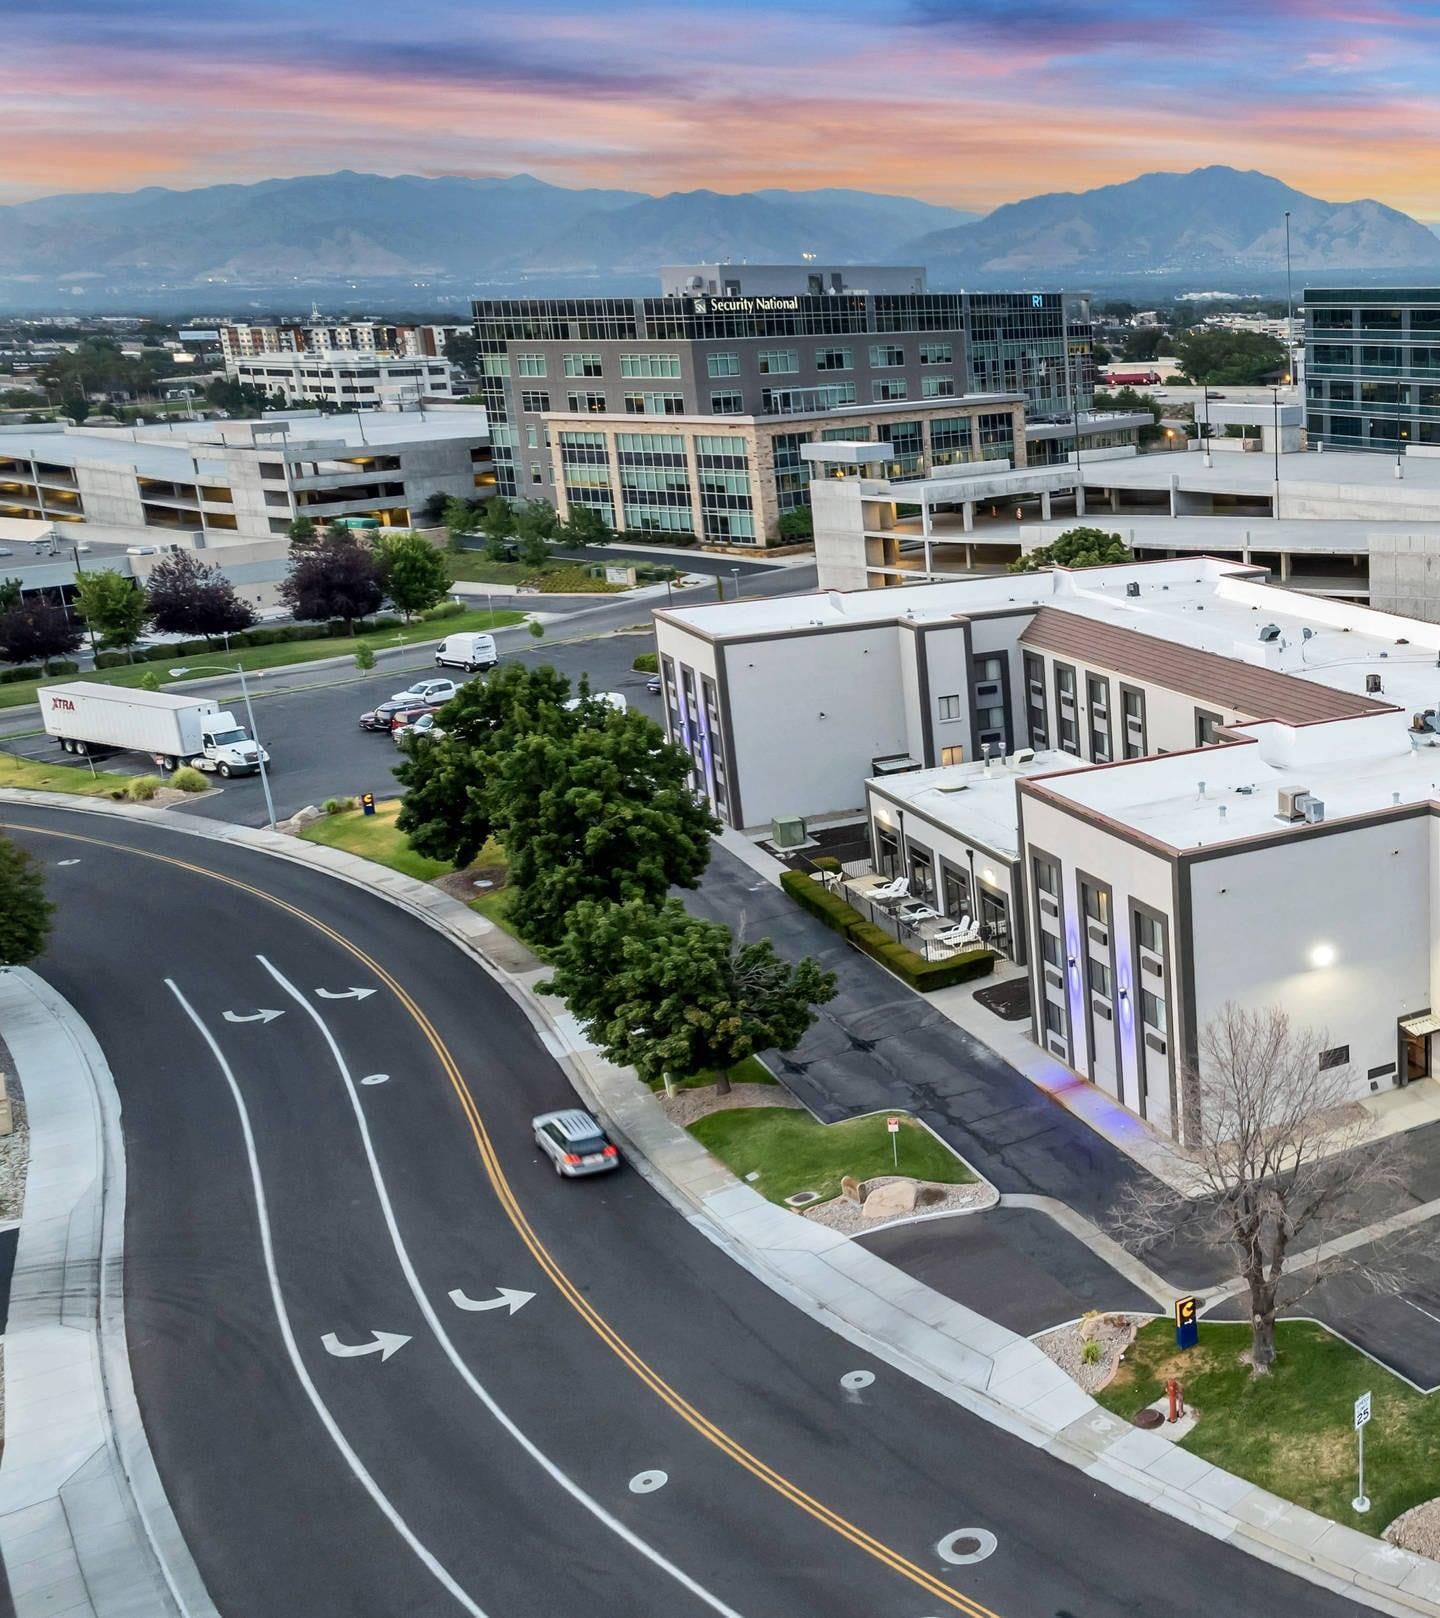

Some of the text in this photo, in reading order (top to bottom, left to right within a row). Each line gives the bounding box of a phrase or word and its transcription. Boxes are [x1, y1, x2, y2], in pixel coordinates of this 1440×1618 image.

[711, 298, 754, 314] Security
[756, 296, 799, 310] National
[52, 697, 75, 711] XTRA
[1356, 1407, 1369, 1426] 25
